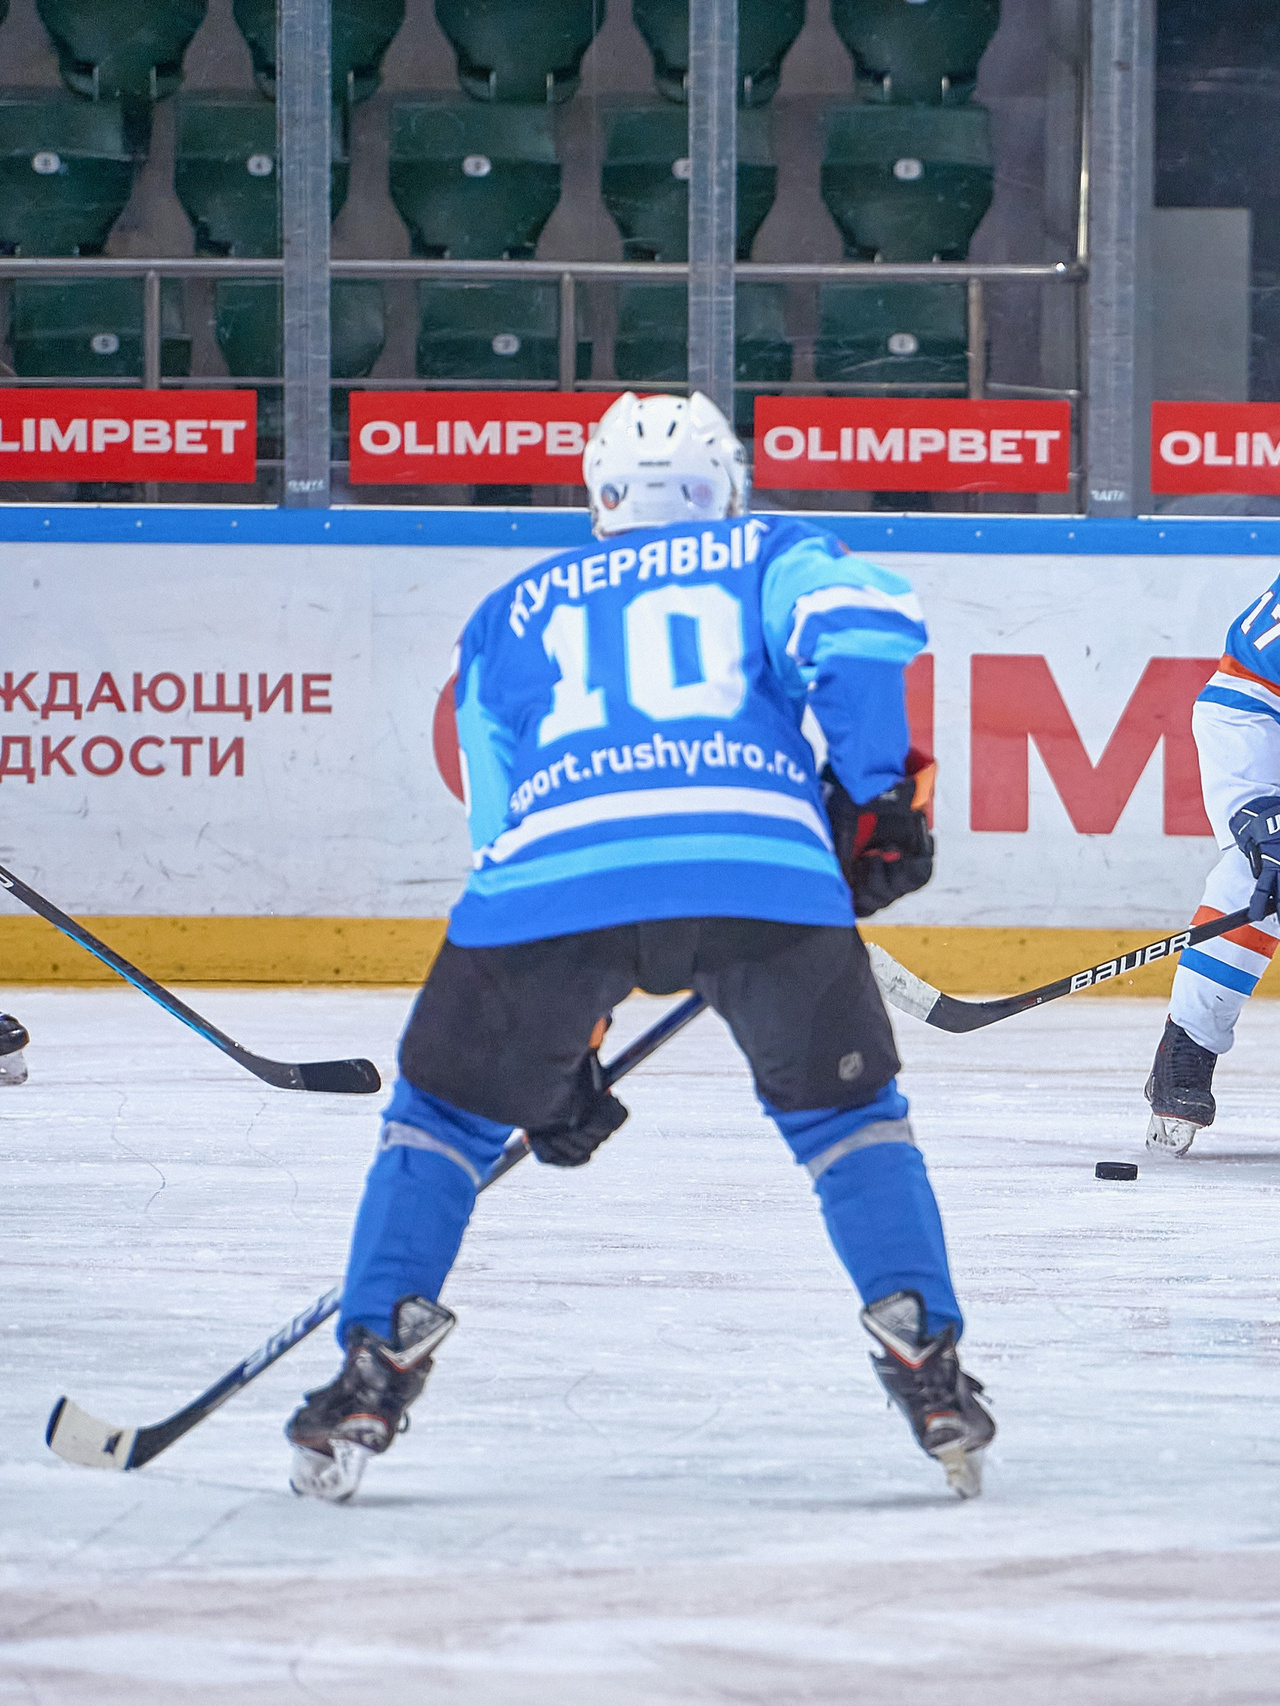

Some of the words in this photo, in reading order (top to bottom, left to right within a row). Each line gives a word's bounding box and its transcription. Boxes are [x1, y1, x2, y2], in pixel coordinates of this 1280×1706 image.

[359, 420, 600, 455] OLIMPB
[763, 426, 1060, 464] OLIMPBET
[538, 582, 748, 748] 10
[0, 671, 332, 722] ЖДАЮЩИЕ
[0, 735, 244, 784] ДКОСТИ
[509, 730, 807, 814] sport.rushydro.ru
